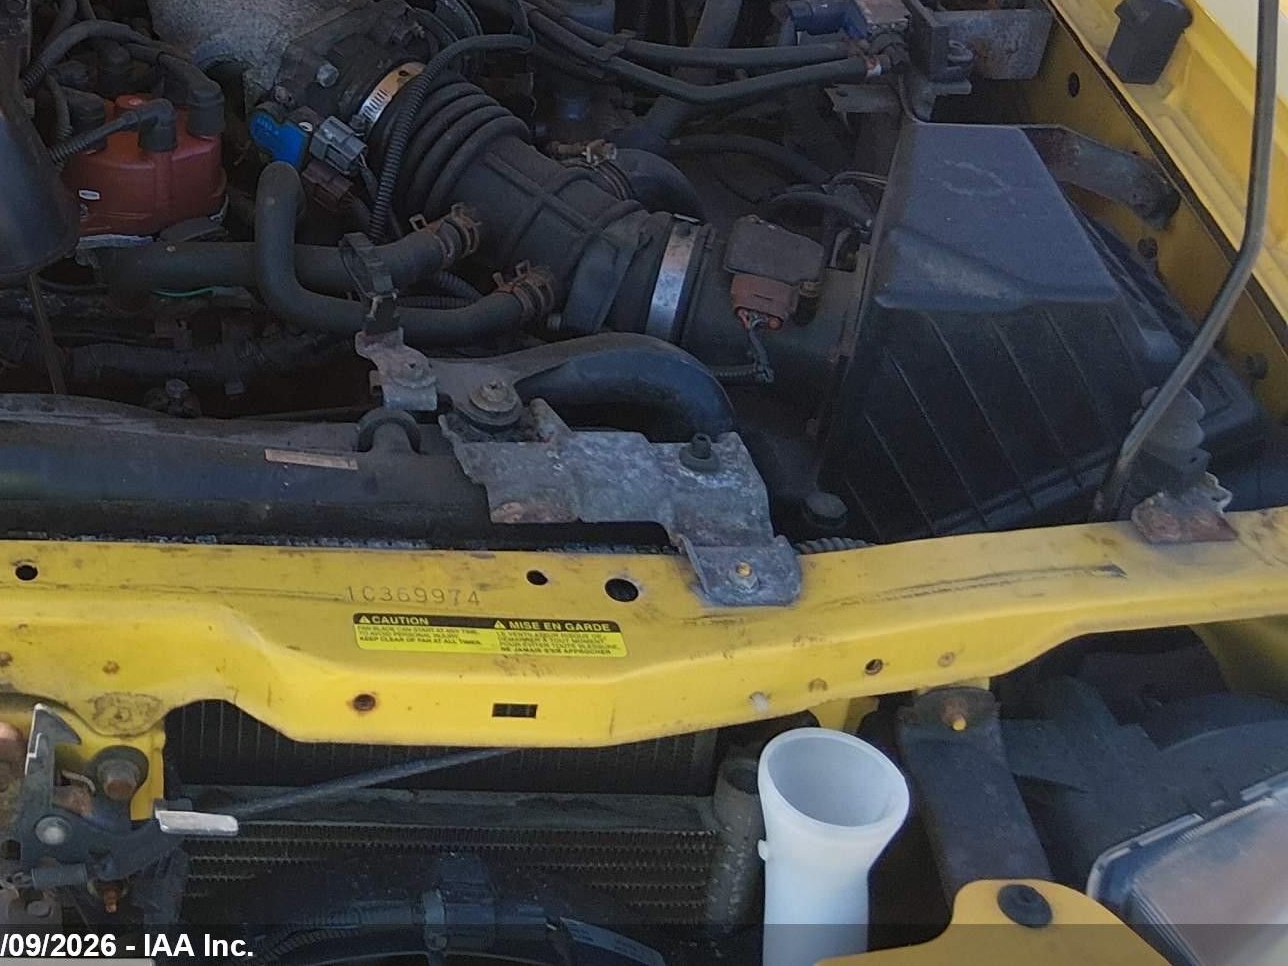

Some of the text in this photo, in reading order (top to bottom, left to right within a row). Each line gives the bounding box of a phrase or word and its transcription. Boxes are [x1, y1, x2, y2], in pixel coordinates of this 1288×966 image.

[347, 585, 481, 606] 1C369974
[371, 615, 429, 626] CAUTION
[508, 620, 611, 632] MISE EN GARDE
